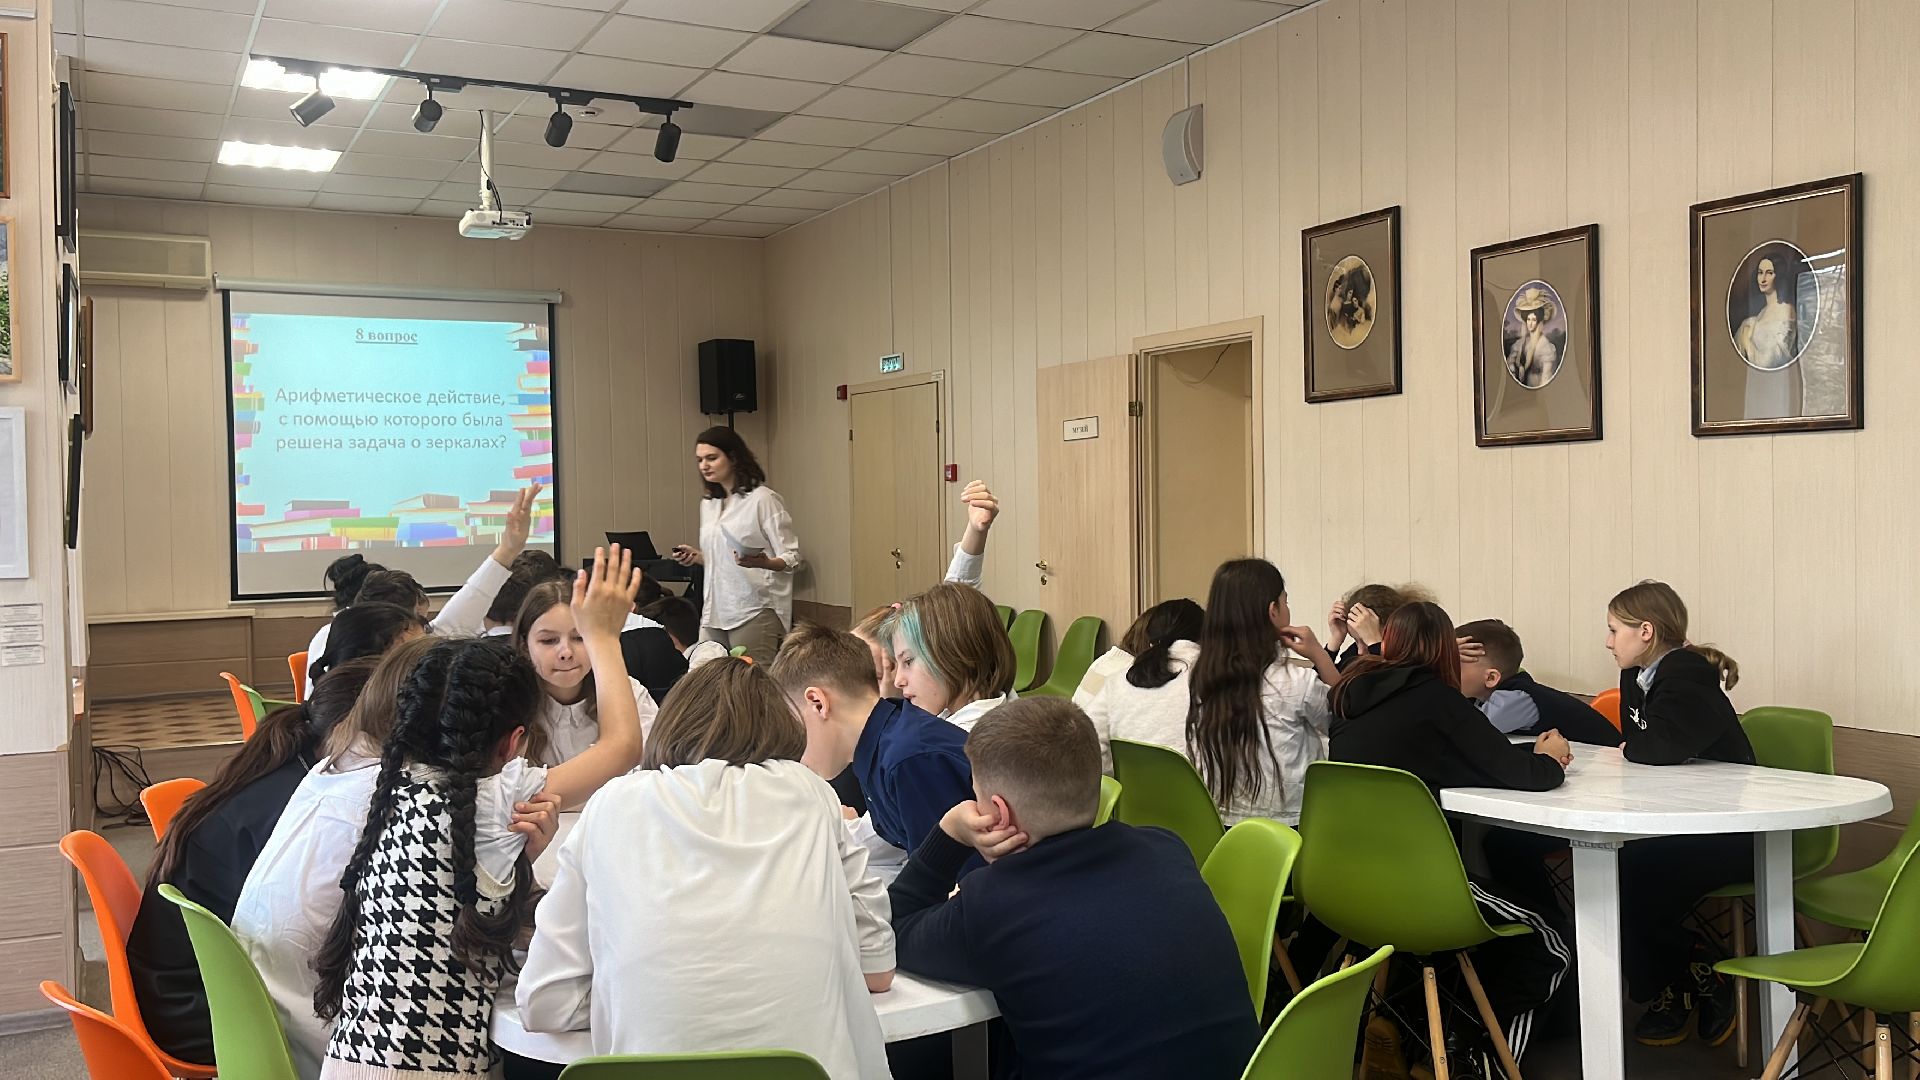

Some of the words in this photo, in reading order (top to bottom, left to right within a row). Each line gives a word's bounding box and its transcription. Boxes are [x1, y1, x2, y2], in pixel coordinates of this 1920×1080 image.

[355, 328, 364, 341] 8
[368, 331, 418, 343] вопрос
[275, 388, 422, 405] Арифметическое
[427, 390, 505, 406] действие,
[279, 413, 288, 425] с
[293, 412, 379, 428] помощью
[383, 413, 457, 429] которого
[462, 412, 503, 427] была
[276, 436, 343, 452] решена
[349, 438, 406, 452] задача
[411, 439, 421, 449] о
[426, 434, 507, 452] зеркалах?
